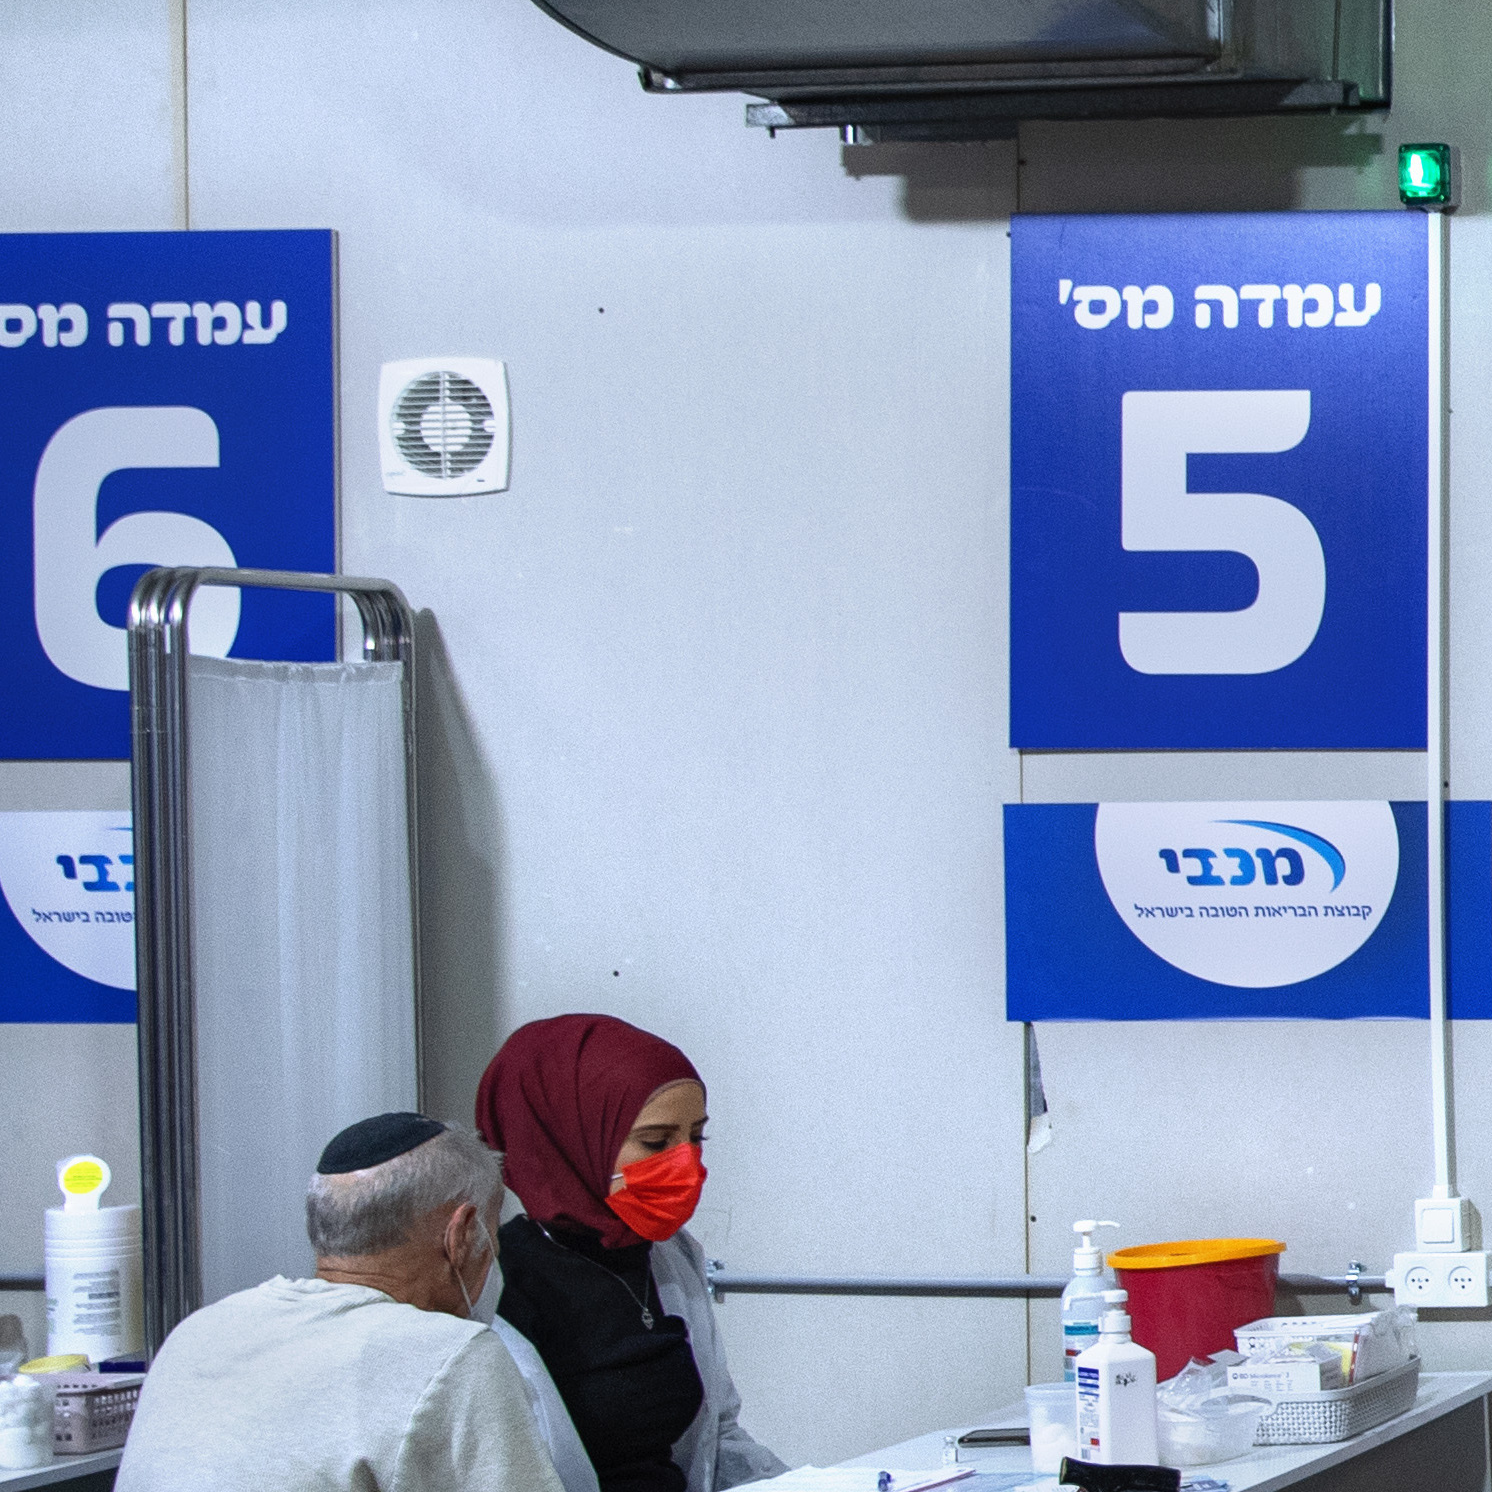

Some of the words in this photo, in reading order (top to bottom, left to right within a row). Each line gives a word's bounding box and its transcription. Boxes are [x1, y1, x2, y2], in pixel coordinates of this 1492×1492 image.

[106, 300, 287, 346] עמדה
[1058, 279, 1174, 330] מס'
[1194, 282, 1382, 329] עמדה
[0, 303, 88, 348] מס
[33, 406, 241, 691] 6
[1118, 389, 1327, 675] 5
[56, 855, 134, 892] בי
[1158, 847, 1306, 886] מכבי
[31, 908, 90, 923] בישראל
[95, 911, 133, 923] טובה
[1134, 903, 1194, 919] בישראל
[1199, 905, 1249, 918] הטובה
[1254, 905, 1319, 918] הבריאות
[1323, 905, 1373, 921] קבוצת
